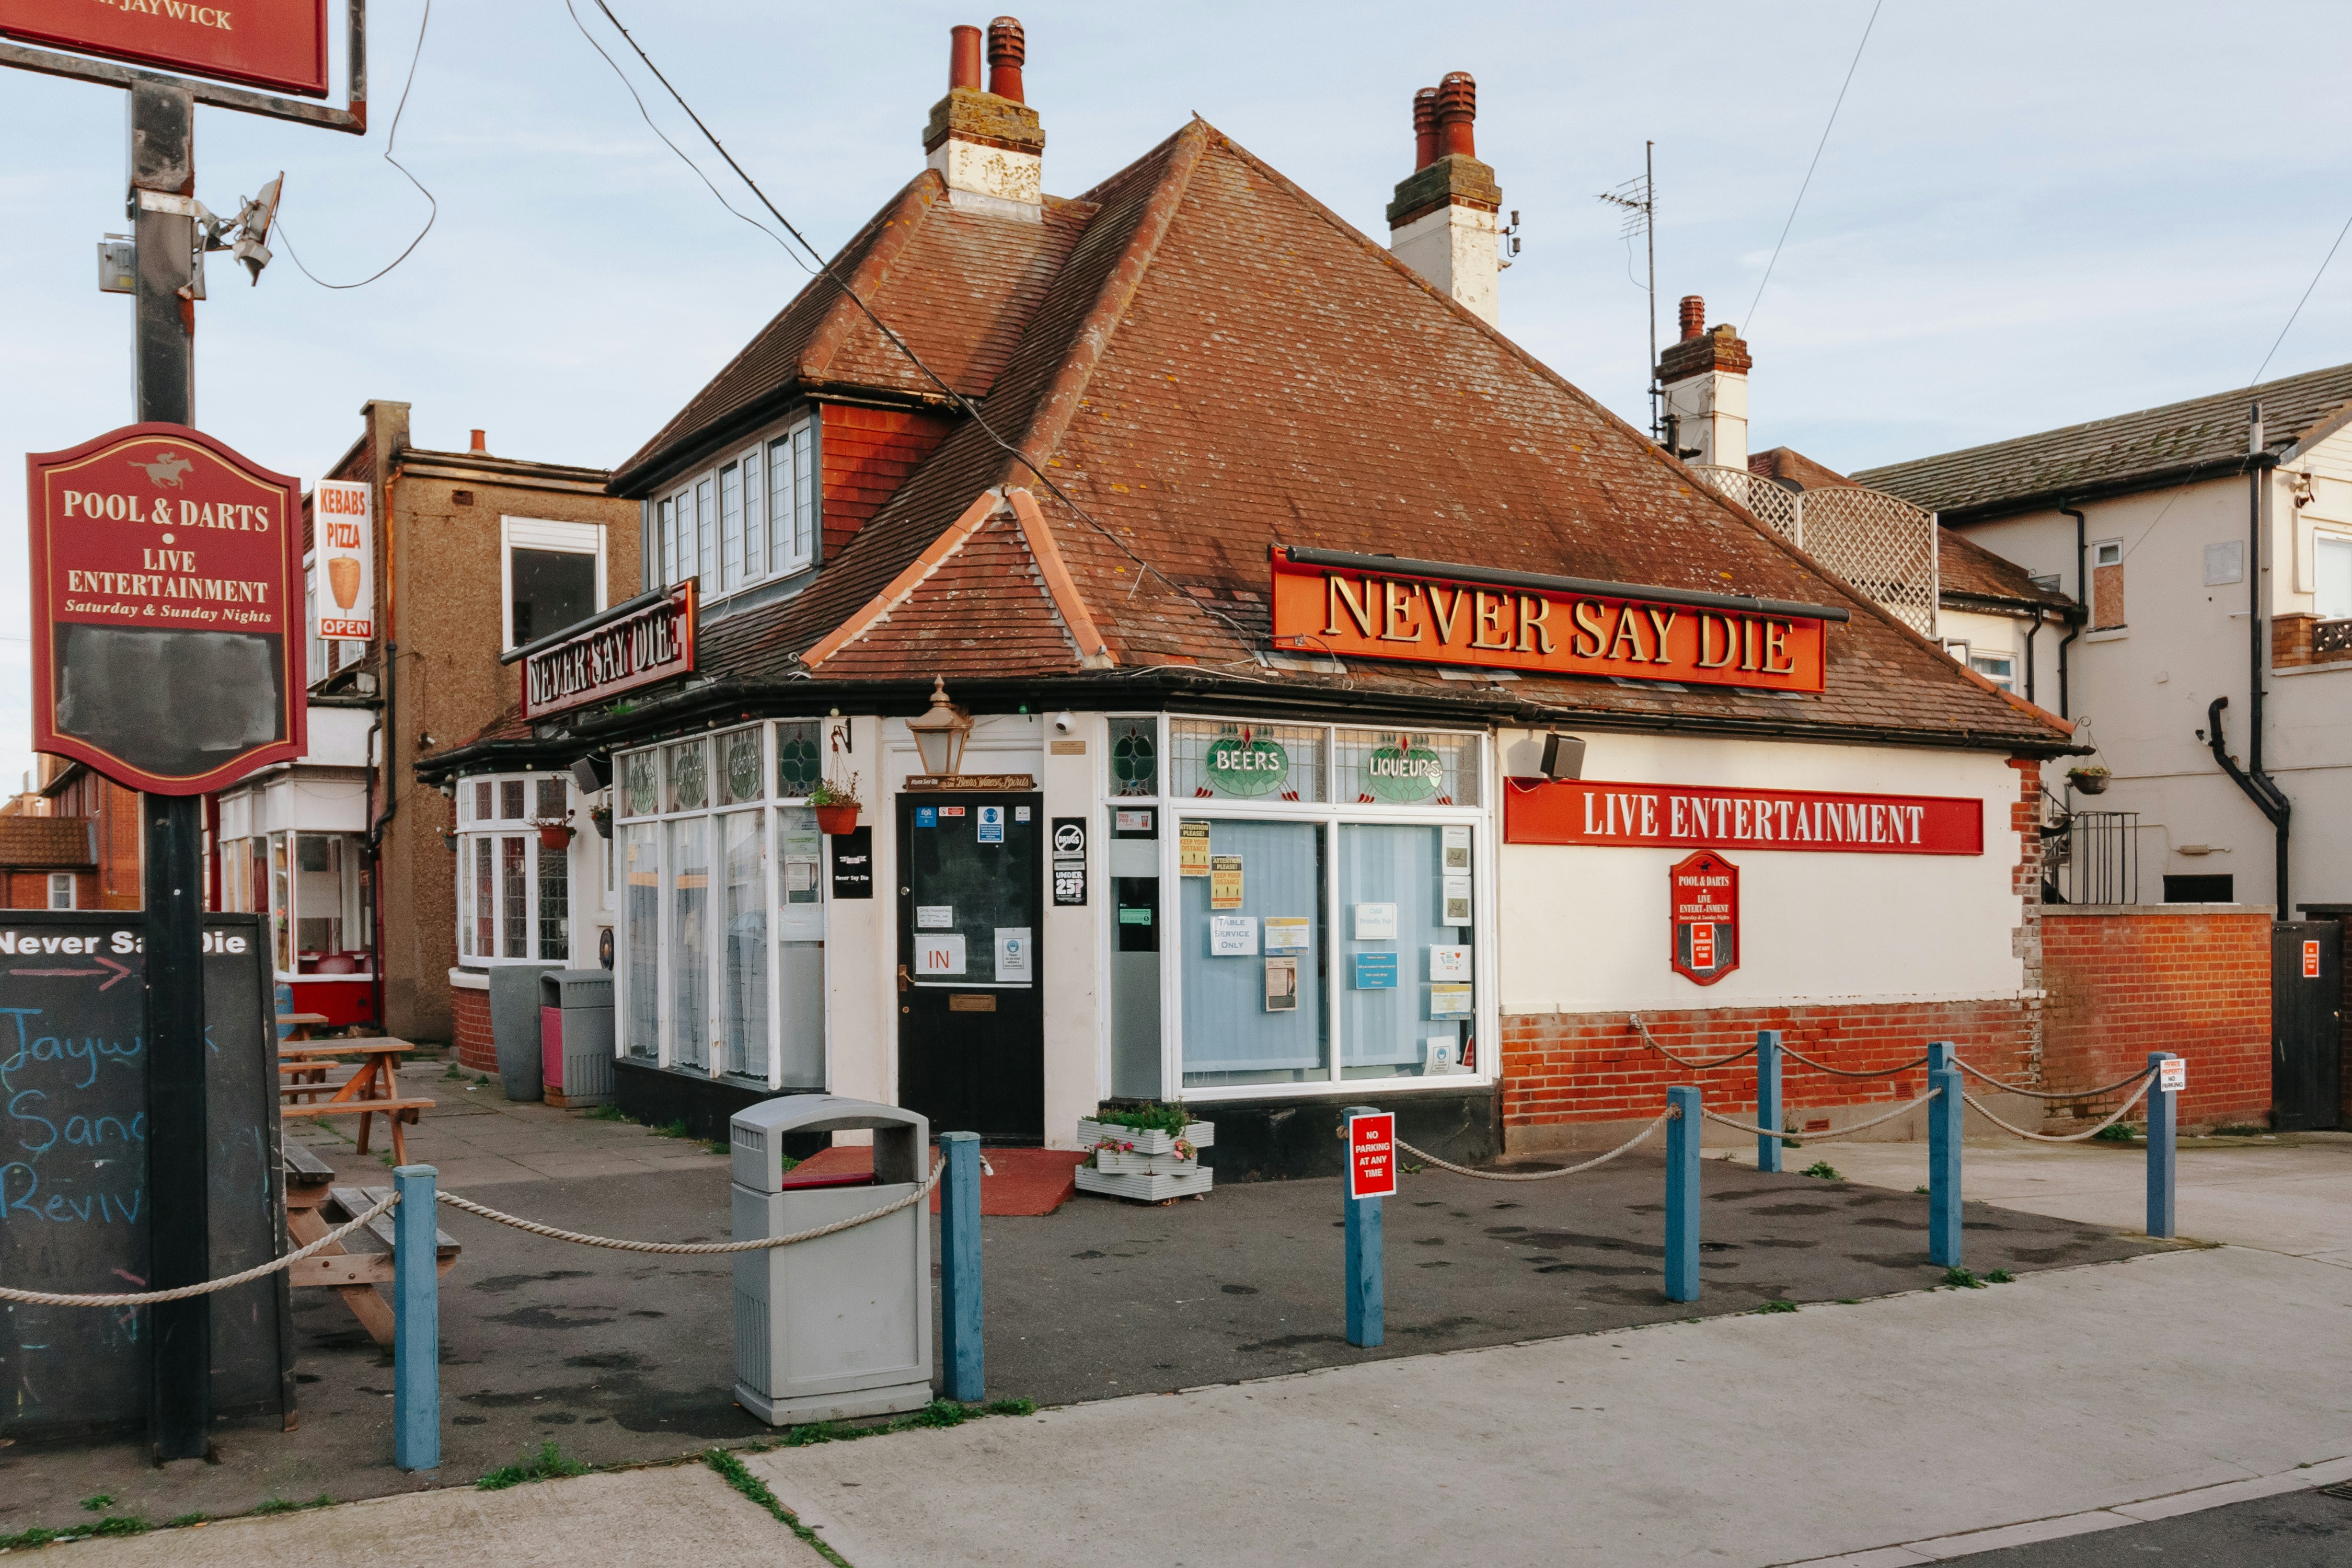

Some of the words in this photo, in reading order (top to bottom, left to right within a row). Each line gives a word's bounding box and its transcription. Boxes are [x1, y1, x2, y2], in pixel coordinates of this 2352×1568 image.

[120, 0, 232, 30] JAYWICK
[63, 490, 145, 523] POOL
[152, 498, 173, 525] &
[179, 500, 268, 532] DARTS
[320, 488, 365, 516] KEBABS
[327, 522, 361, 549] PIZZA
[143, 548, 196, 573] LIVE
[68, 570, 268, 603] ENTERTAINMENT
[65, 599, 138, 618] Saturday
[143, 604, 156, 616] &
[160, 605, 218, 622] Sunday
[222, 609, 272, 624] Nights
[1323, 570, 1556, 654] NEVER
[1572, 597, 1680, 663] SAY
[1697, 609, 1794, 674] DIE
[323, 620, 368, 635] OPEN
[529, 642, 587, 706] NEVER
[591, 625, 627, 684] SAY
[632, 606, 673, 672] DIE
[1217, 751, 1280, 770] BEERS
[1370, 757, 1442, 778] LIQUEURS
[1583, 792, 1658, 836] LIVE
[1670, 796, 1924, 844] ENTERTAINMENT
[1058, 836, 1080, 844] DRUGS
[1056, 879, 1083, 897] 25?
[1678, 876, 1699, 886] POOL
[1700, 876, 1705, 886] &
[1707, 876, 1729, 886] DARTS
[1679, 904, 1729, 913] ENTERTINMENT
[1697, 895, 1711, 903] LIVE
[0, 931, 100, 954] Never
[929, 950, 949, 969] IN
[9, 1089, 144, 1150] San
[1366, 1131, 1378, 1139] NO
[1355, 1142, 1390, 1153] PARKING
[1359, 1157, 1369, 1166] AT
[1370, 1156, 1387, 1165] ANY
[1364, 1168, 1383, 1178] TIME
